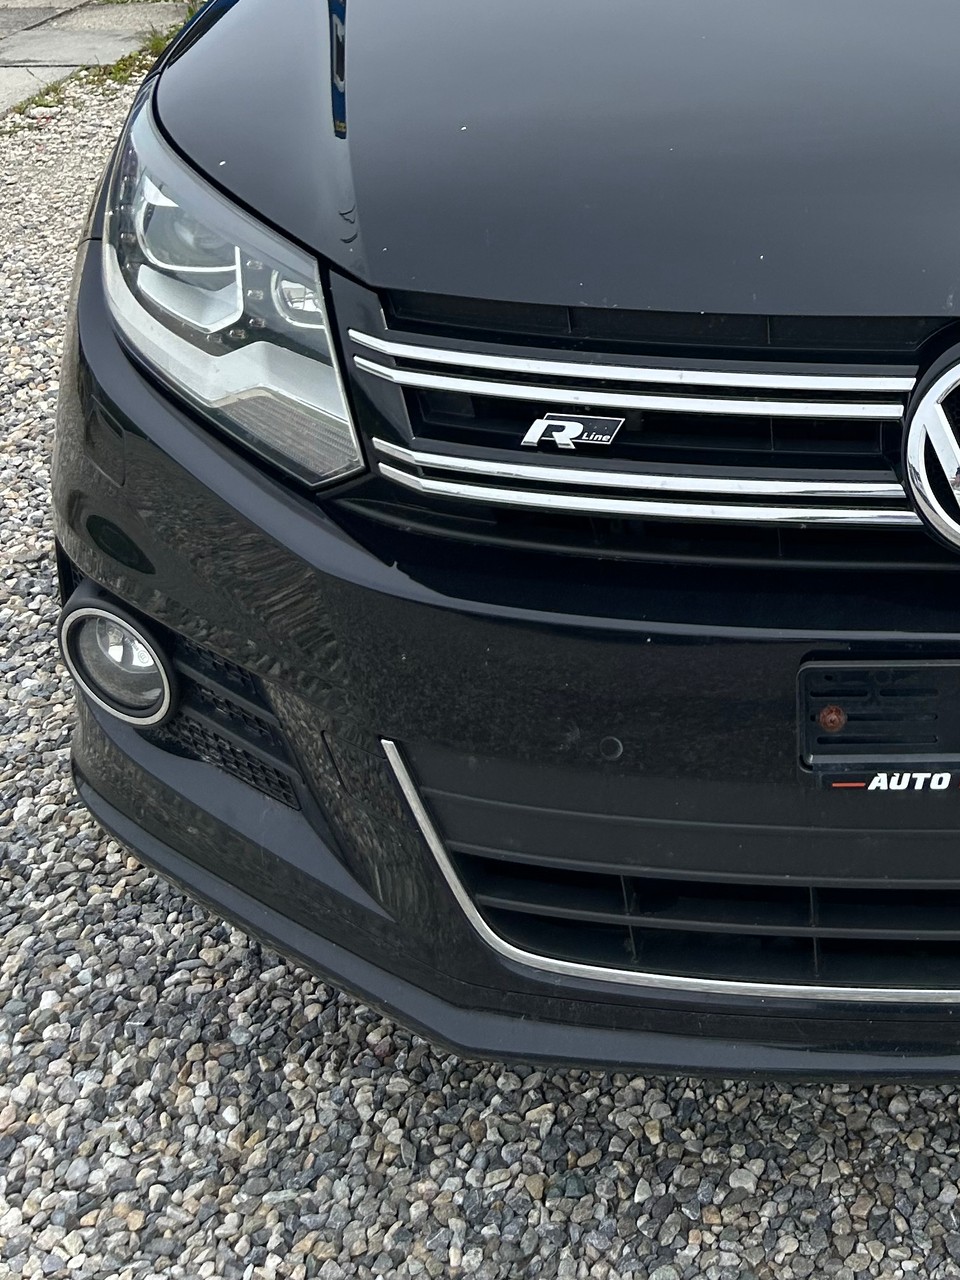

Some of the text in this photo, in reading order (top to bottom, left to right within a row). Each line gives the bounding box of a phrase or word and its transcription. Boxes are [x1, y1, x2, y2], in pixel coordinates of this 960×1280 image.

[520, 419, 611, 449] R Line
[868, 772, 951, 791] AUTO
